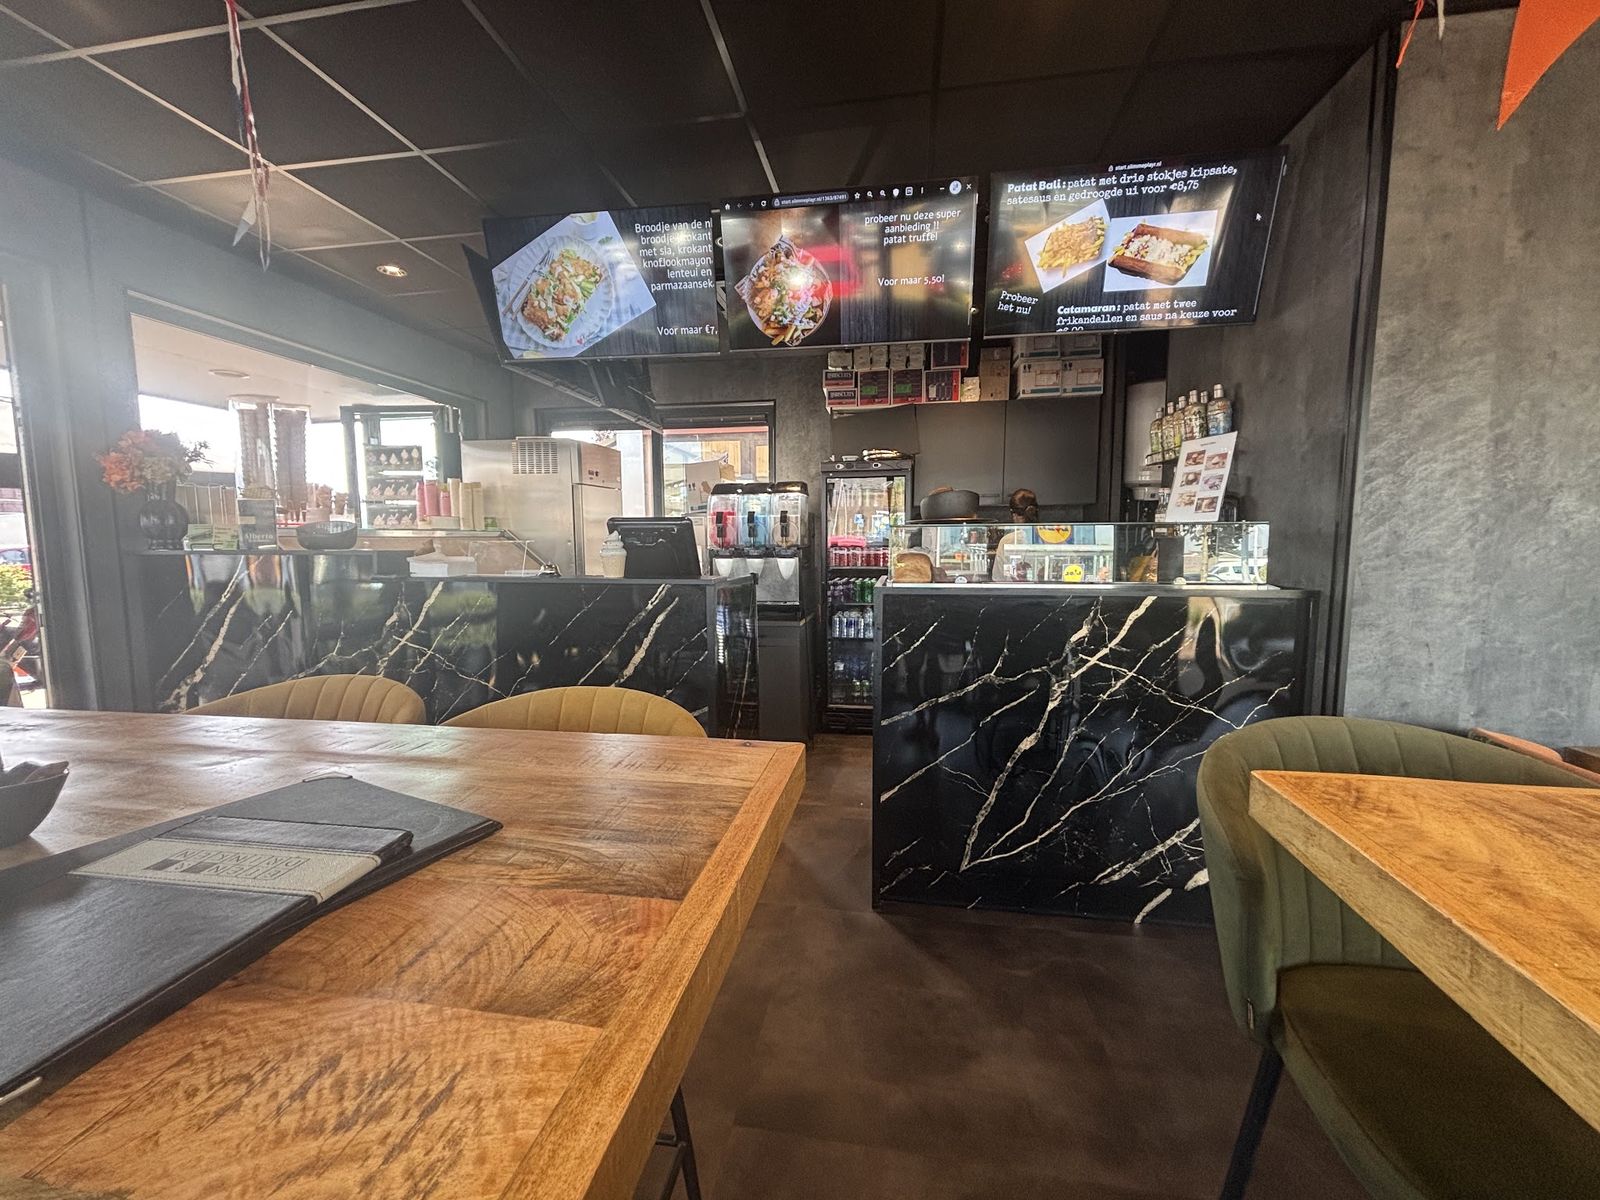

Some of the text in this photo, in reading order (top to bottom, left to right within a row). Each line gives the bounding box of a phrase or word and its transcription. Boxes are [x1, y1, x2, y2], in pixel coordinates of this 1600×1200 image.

[1007, 165, 1237, 193] Patat Bali: patat met drie stokjes kipsate,
[1007, 179, 1199, 205] satesaus en gedroogde ui voor €8,75
[864, 209, 961, 227] probeer nu deze super
[634, 221, 670, 234] Broodje
[672, 221, 689, 231] van
[691, 219, 702, 230] de
[884, 222, 931, 234] aanbieding
[641, 233, 675, 246] broodje
[883, 232, 938, 246] patat truffel
[640, 243, 713, 256] met sla, krokant
[642, 256, 714, 268] knoflookmayon
[667, 268, 712, 279] lenteui en
[878, 273, 945, 286] Voor maar 5,50!
[650, 278, 715, 293] parmazaansek
[1000, 290, 1039, 305] Probeer
[997, 301, 1032, 315] het nu!
[1057, 299, 1198, 314] Catamaran: patat met twee
[1056, 308, 1238, 326] frikandellen en saus na keuze voor
[656, 326, 679, 336] Voor
[680, 326, 703, 335] maar
